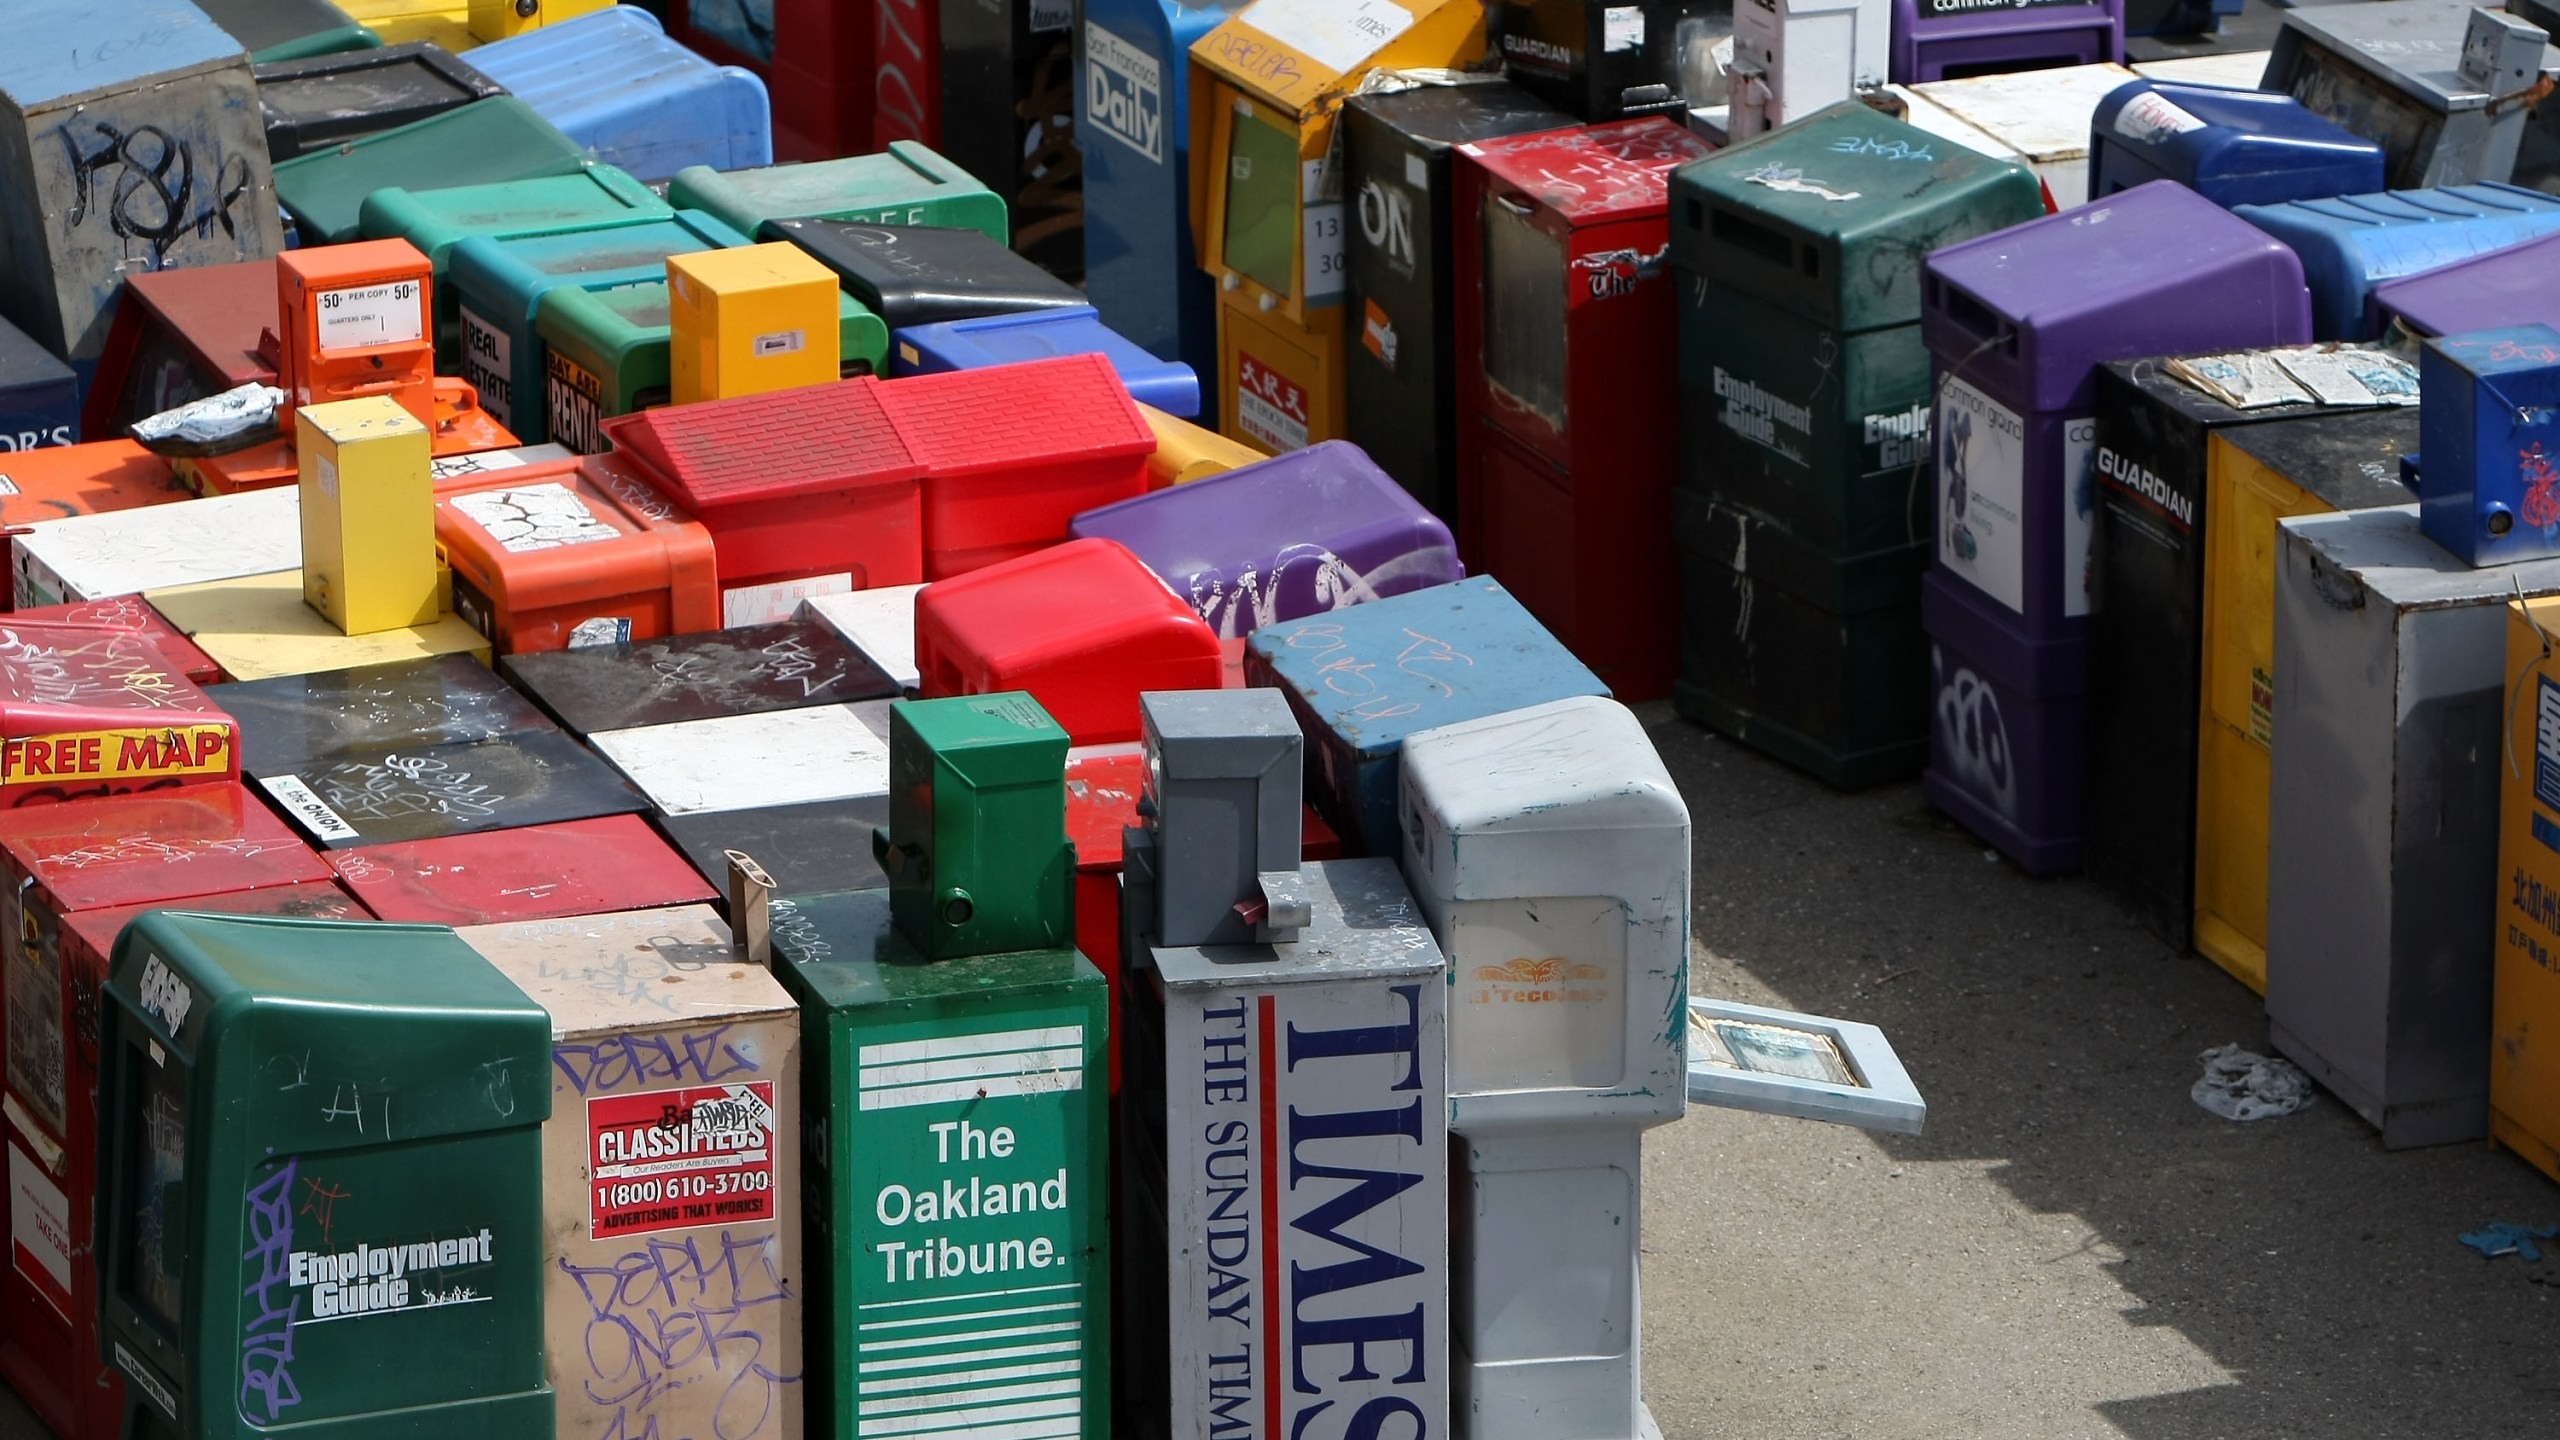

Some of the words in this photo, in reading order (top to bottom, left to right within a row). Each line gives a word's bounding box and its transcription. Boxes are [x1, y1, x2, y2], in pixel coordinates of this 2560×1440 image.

[1087, 27, 1108, 58] San
[1110, 40, 1158, 88] Francisco
[1504, 34, 1570, 63] GUARDIAN
[1091, 62, 1160, 152] Daily
[1315, 218, 1338, 238] 13
[1320, 253, 1345, 274] 30
[1589, 266, 1635, 299] The
[349, 290, 365, 300] PER
[367, 289, 388, 298] COPY
[328, 316, 359, 325] QUARTERS
[469, 322, 499, 362] REAL
[470, 359, 511, 405] ESTATE
[550, 353, 571, 378] BAY
[576, 370, 599, 398] ARE
[551, 377, 602, 455] RENTA
[1714, 366, 1811, 435] Employment
[1727, 400, 1774, 445] Guide
[1943, 382, 1986, 418] common
[1988, 407, 2023, 441] ground
[2099, 446, 2192, 525] GUARDIAN
[2, 738, 101, 777] FREE
[117, 732, 223, 771] MAP
[303, 804, 346, 832] ONION
[2513, 866, 2560, 936] 北加州
[1202, 997, 1247, 1105] THE
[930, 1122, 1016, 1163] The
[633, 1165, 649, 1175] Our
[650, 1160, 684, 1172] Readers
[686, 1159, 701, 1168] Are
[703, 1156, 730, 1169] Buyers
[666, 1171, 769, 1199] 610-3700
[604, 1206, 679, 1229] ADVERTISING
[683, 1203, 712, 1219] THAT
[716, 1199, 764, 1216] WORKS!
[877, 1169, 1067, 1226] Oakland
[34, 1212, 53, 1245] TAKE
[53, 1239, 70, 1261] ONE
[1204, 1121, 1250, 1330] SUNDAY
[289, 1228, 493, 1287] Employment
[877, 1237, 1065, 1283] Tribune.
[312, 1274, 409, 1318] Guide
